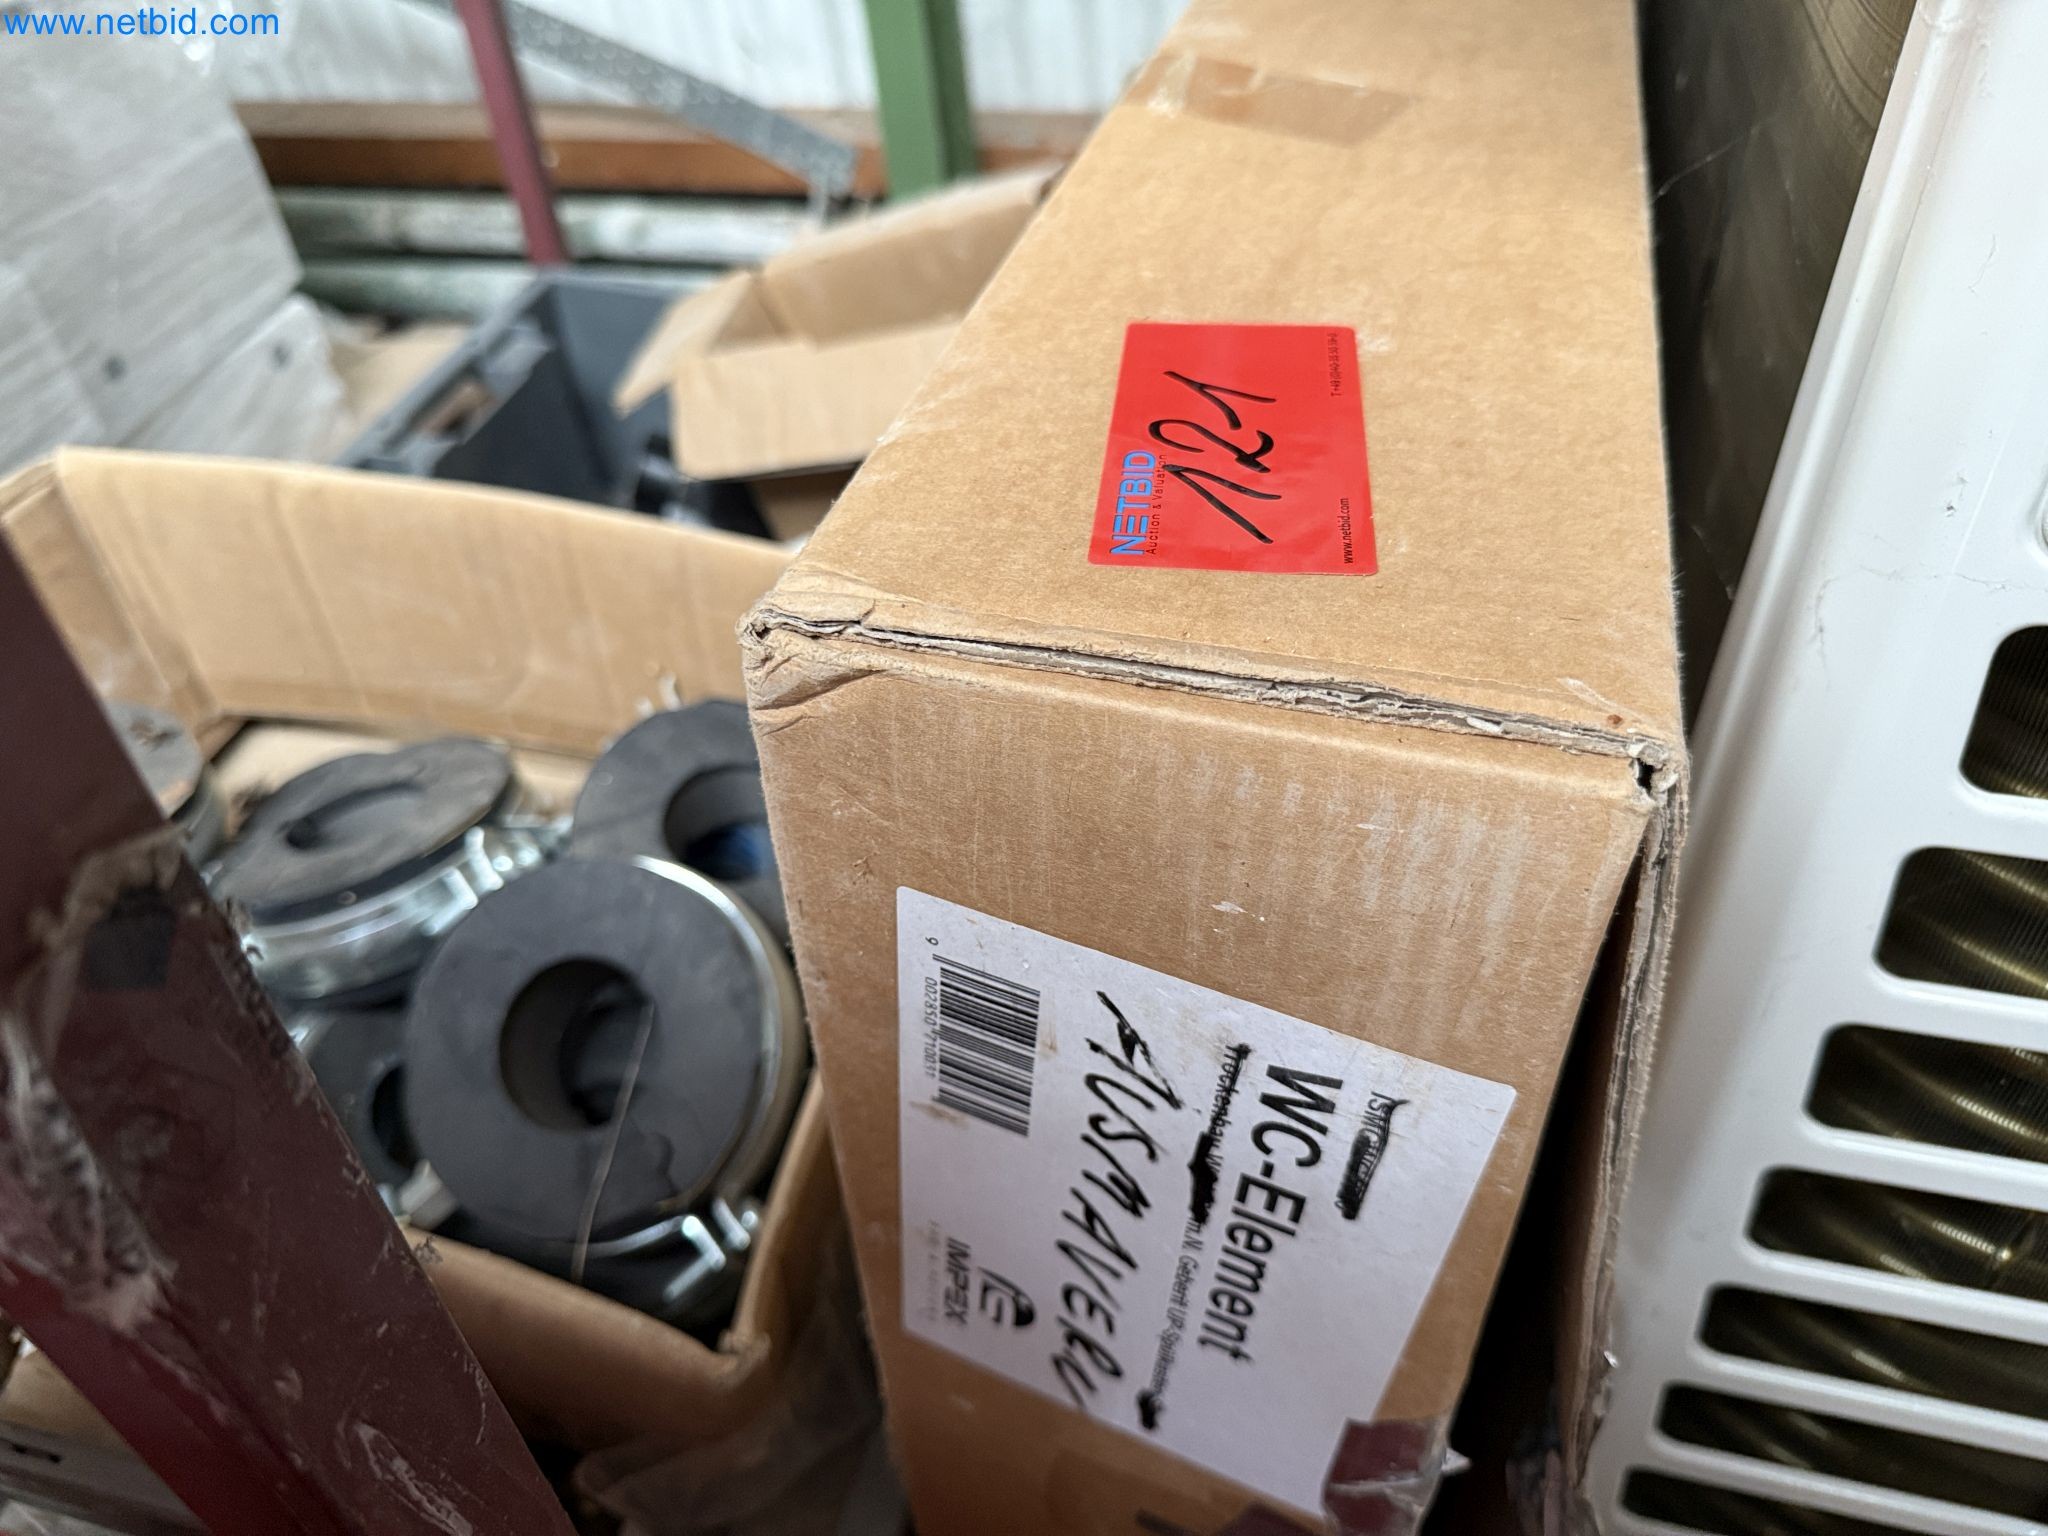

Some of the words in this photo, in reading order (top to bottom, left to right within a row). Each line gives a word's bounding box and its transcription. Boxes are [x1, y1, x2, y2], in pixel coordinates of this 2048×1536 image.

[1148, 371, 1282, 544] 121
[1109, 450, 1156, 555] NETBID
[1146, 514, 1160, 555] Auction
[1337, 497, 1354, 564] www.netbid.com
[925, 937, 939, 946] 9
[924, 976, 938, 1026] 002850
[1198, 1063, 1344, 1365] WC-Element
[943, 1236, 972, 1326] IMPEX
[1171, 1255, 1199, 1308] Geberit
